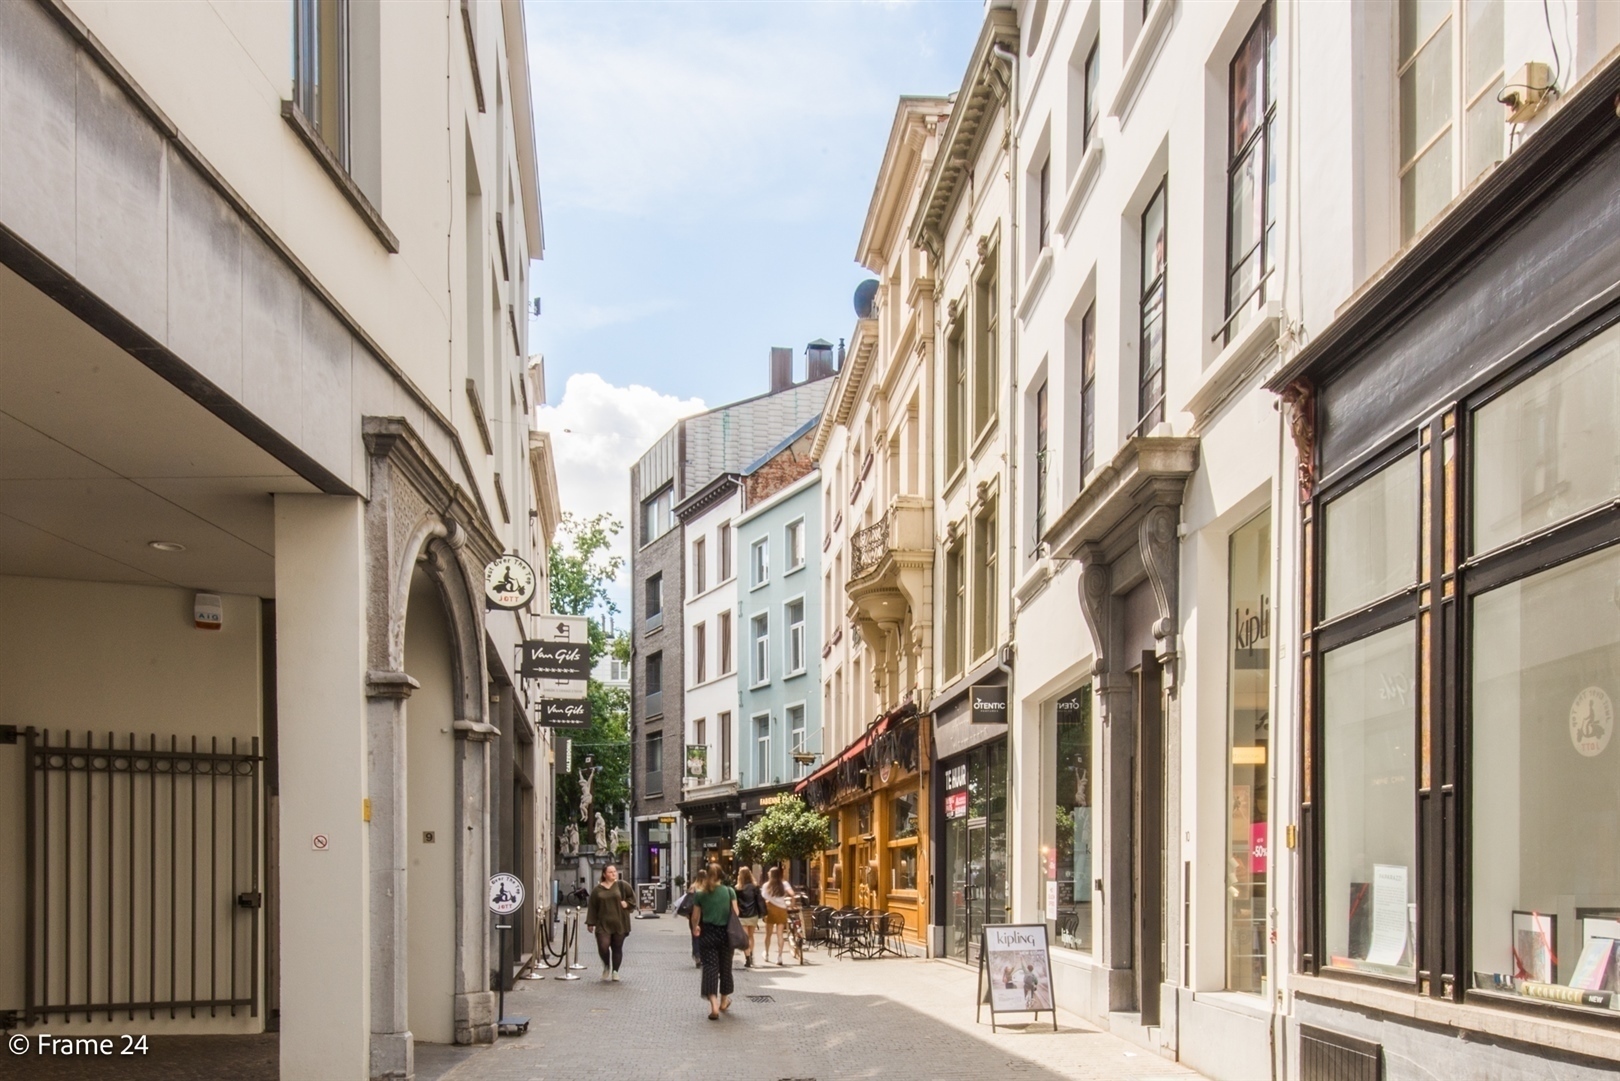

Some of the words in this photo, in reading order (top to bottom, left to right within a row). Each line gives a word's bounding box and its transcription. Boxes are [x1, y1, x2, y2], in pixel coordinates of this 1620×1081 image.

[514, 558, 526, 570] The
[531, 647, 553, 660] Van
[555, 648, 580, 664] Gils
[547, 704, 564, 714] Van
[565, 704, 584, 717] Gils
[973, 701, 1006, 710] OTENTIC
[425, 832, 433, 842] 9
[1588, 995, 1604, 1004] NEW
